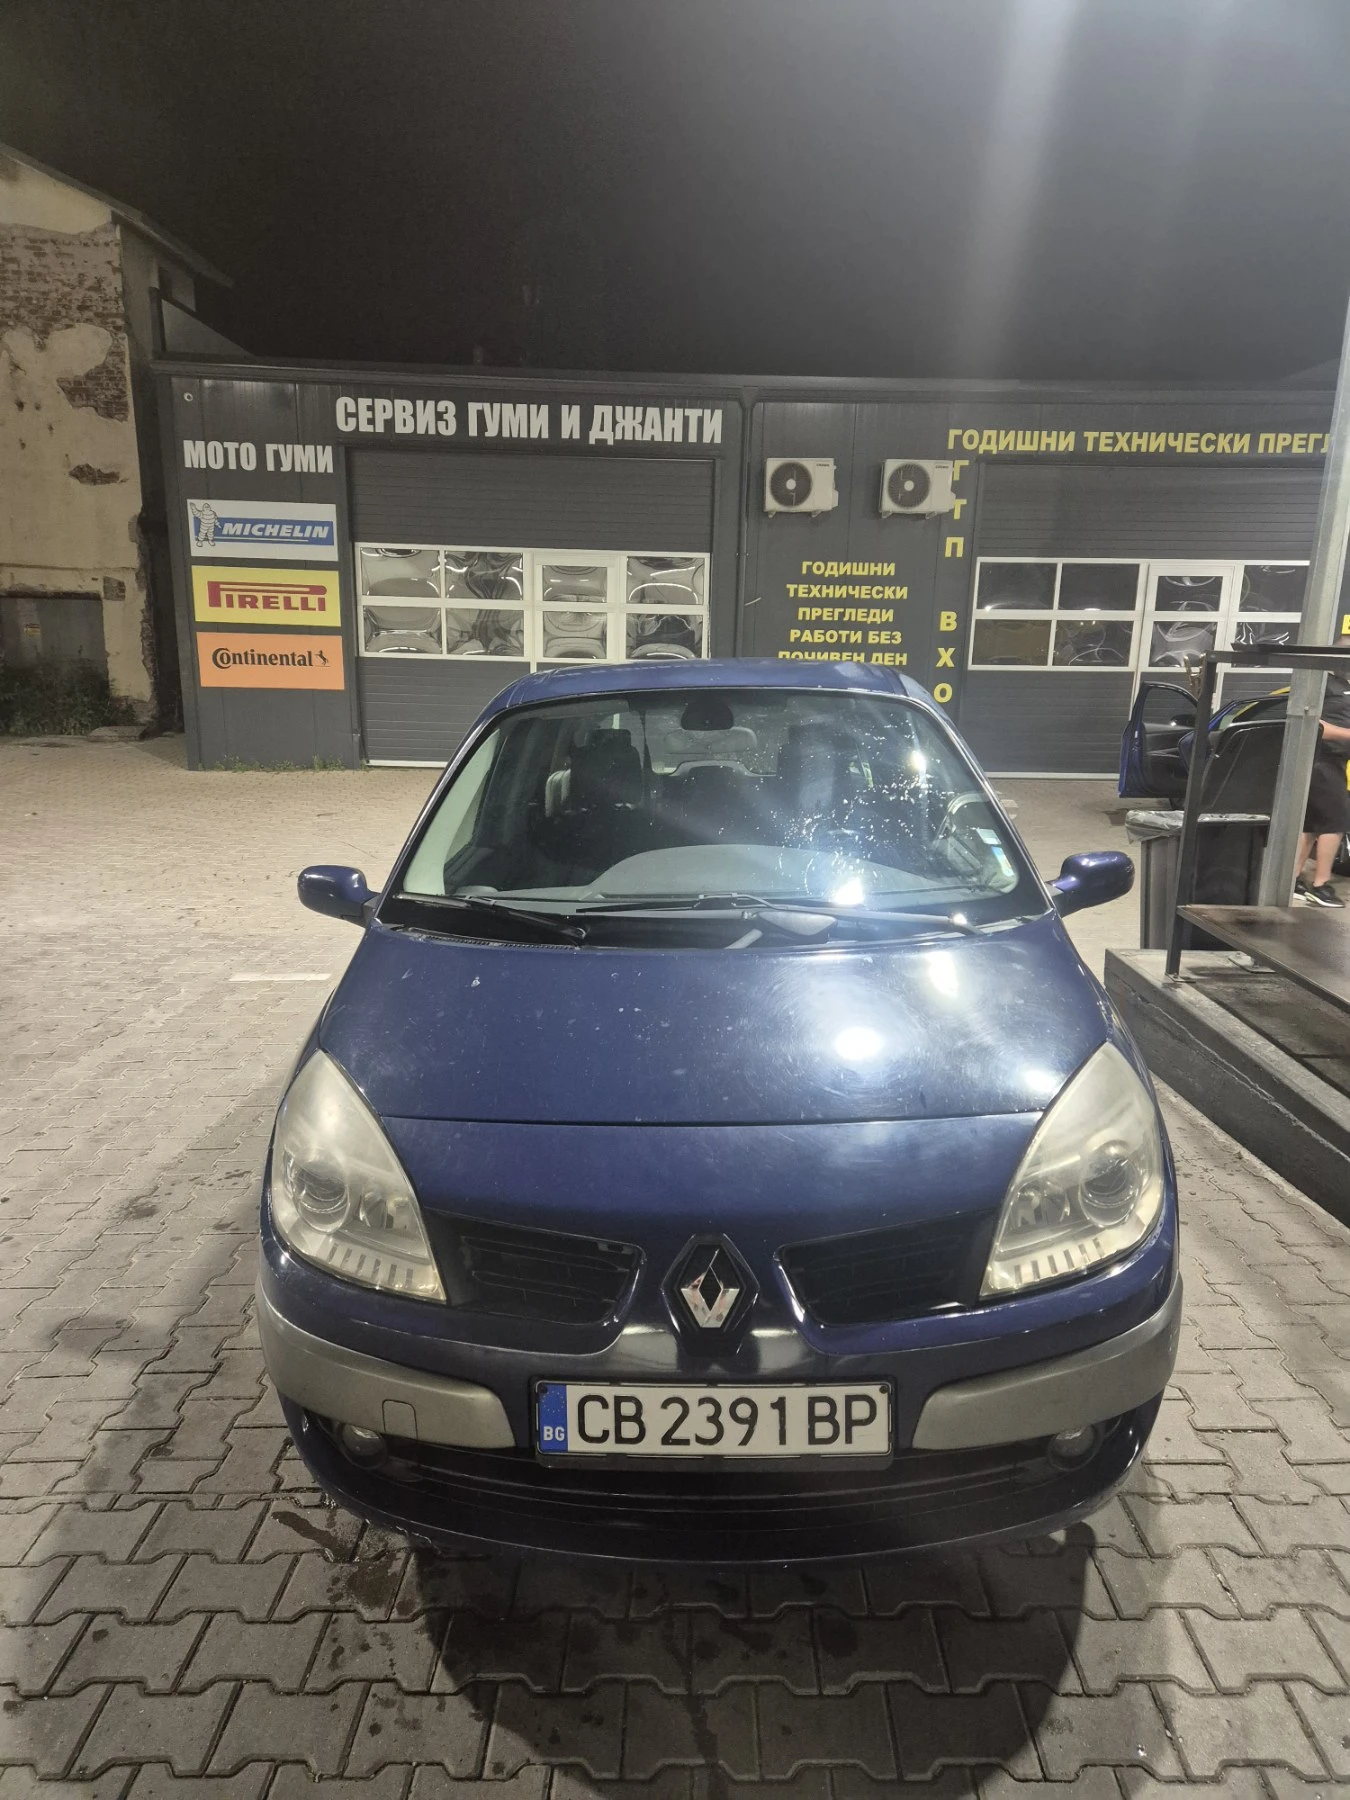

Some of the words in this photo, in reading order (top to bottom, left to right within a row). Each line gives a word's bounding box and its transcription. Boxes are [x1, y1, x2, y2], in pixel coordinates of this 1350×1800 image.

[335, 396, 457, 436] СЕРВИЗ
[467, 402, 549, 439] ГУМИ
[561, 405, 581, 439] И
[588, 405, 723, 446] ДЖАНТИ
[947, 429, 1076, 454] ГОДИШНИ
[1083, 431, 1251, 453] ТЕХНИЧЕСКИ
[183, 440, 257, 471] МОТО
[265, 444, 334, 473] ГУМИ
[222, 522, 329, 539] MICHELIN
[801, 561, 895, 577] ГОДИШНИ
[207, 580, 327, 612] PIRELLI
[786, 584, 908, 599] ТЕХНИЧЕСКИ
[797, 607, 894, 624] ПРЕГЛЕДИ
[789, 629, 862, 643] РАБОТИ
[867, 631, 902, 644] БЕЗ
[211, 647, 313, 669] Continental
[870, 652, 908, 666] ДЕН
[577, 1394, 646, 1445] CB
[659, 1396, 787, 1446] 2391
[807, 1394, 878, 1446] BP
[543, 1426, 566, 1442] BG
